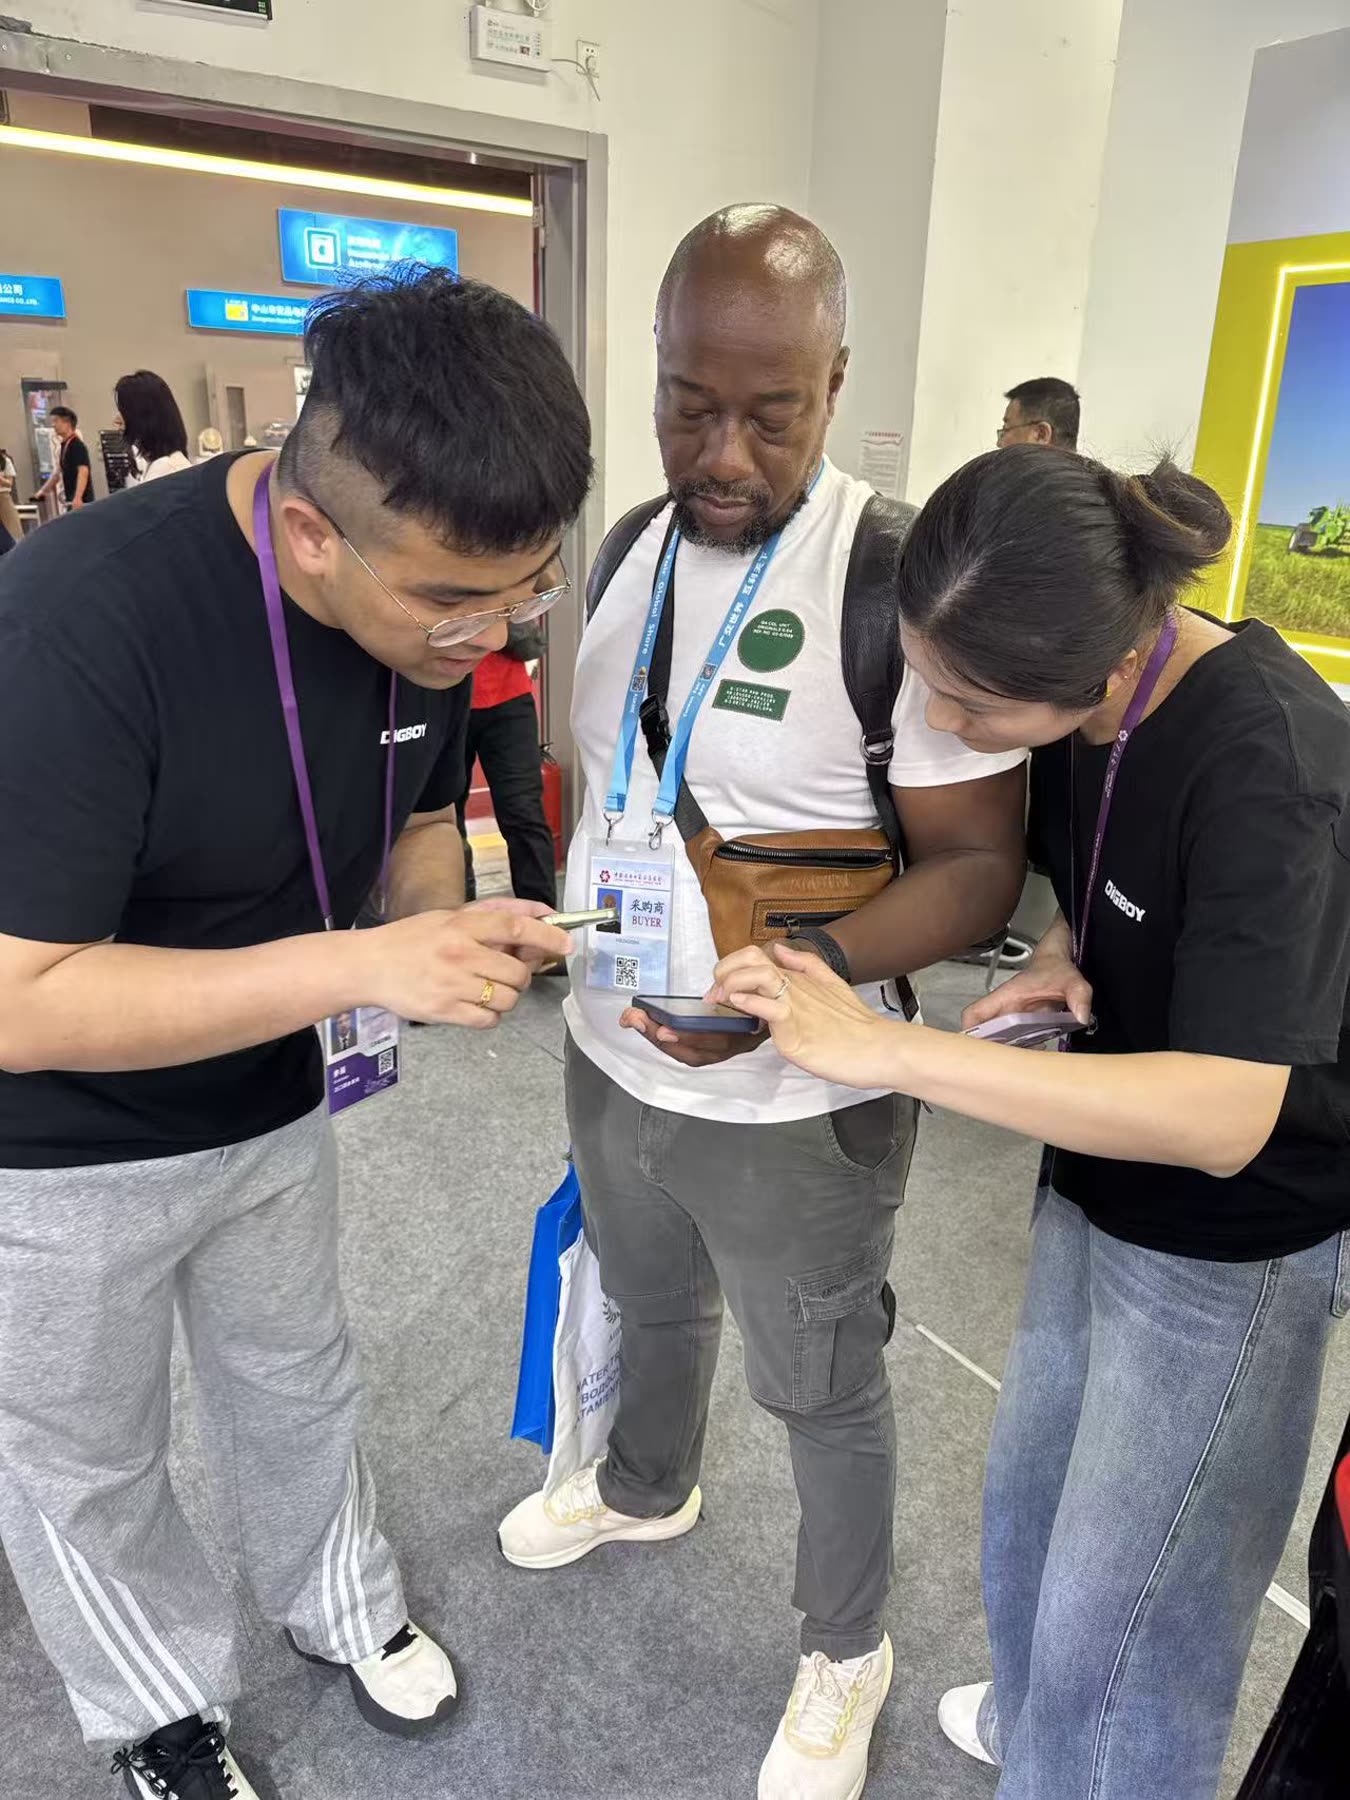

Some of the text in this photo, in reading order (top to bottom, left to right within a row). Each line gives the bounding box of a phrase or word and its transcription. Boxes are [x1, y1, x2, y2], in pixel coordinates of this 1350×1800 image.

[0, 283, 23, 296] 公司
[652, 581, 664, 617] Global
[642, 623, 655, 655] Share
[630, 898, 665, 915] 采购商
[632, 915, 662, 928] BUYER
